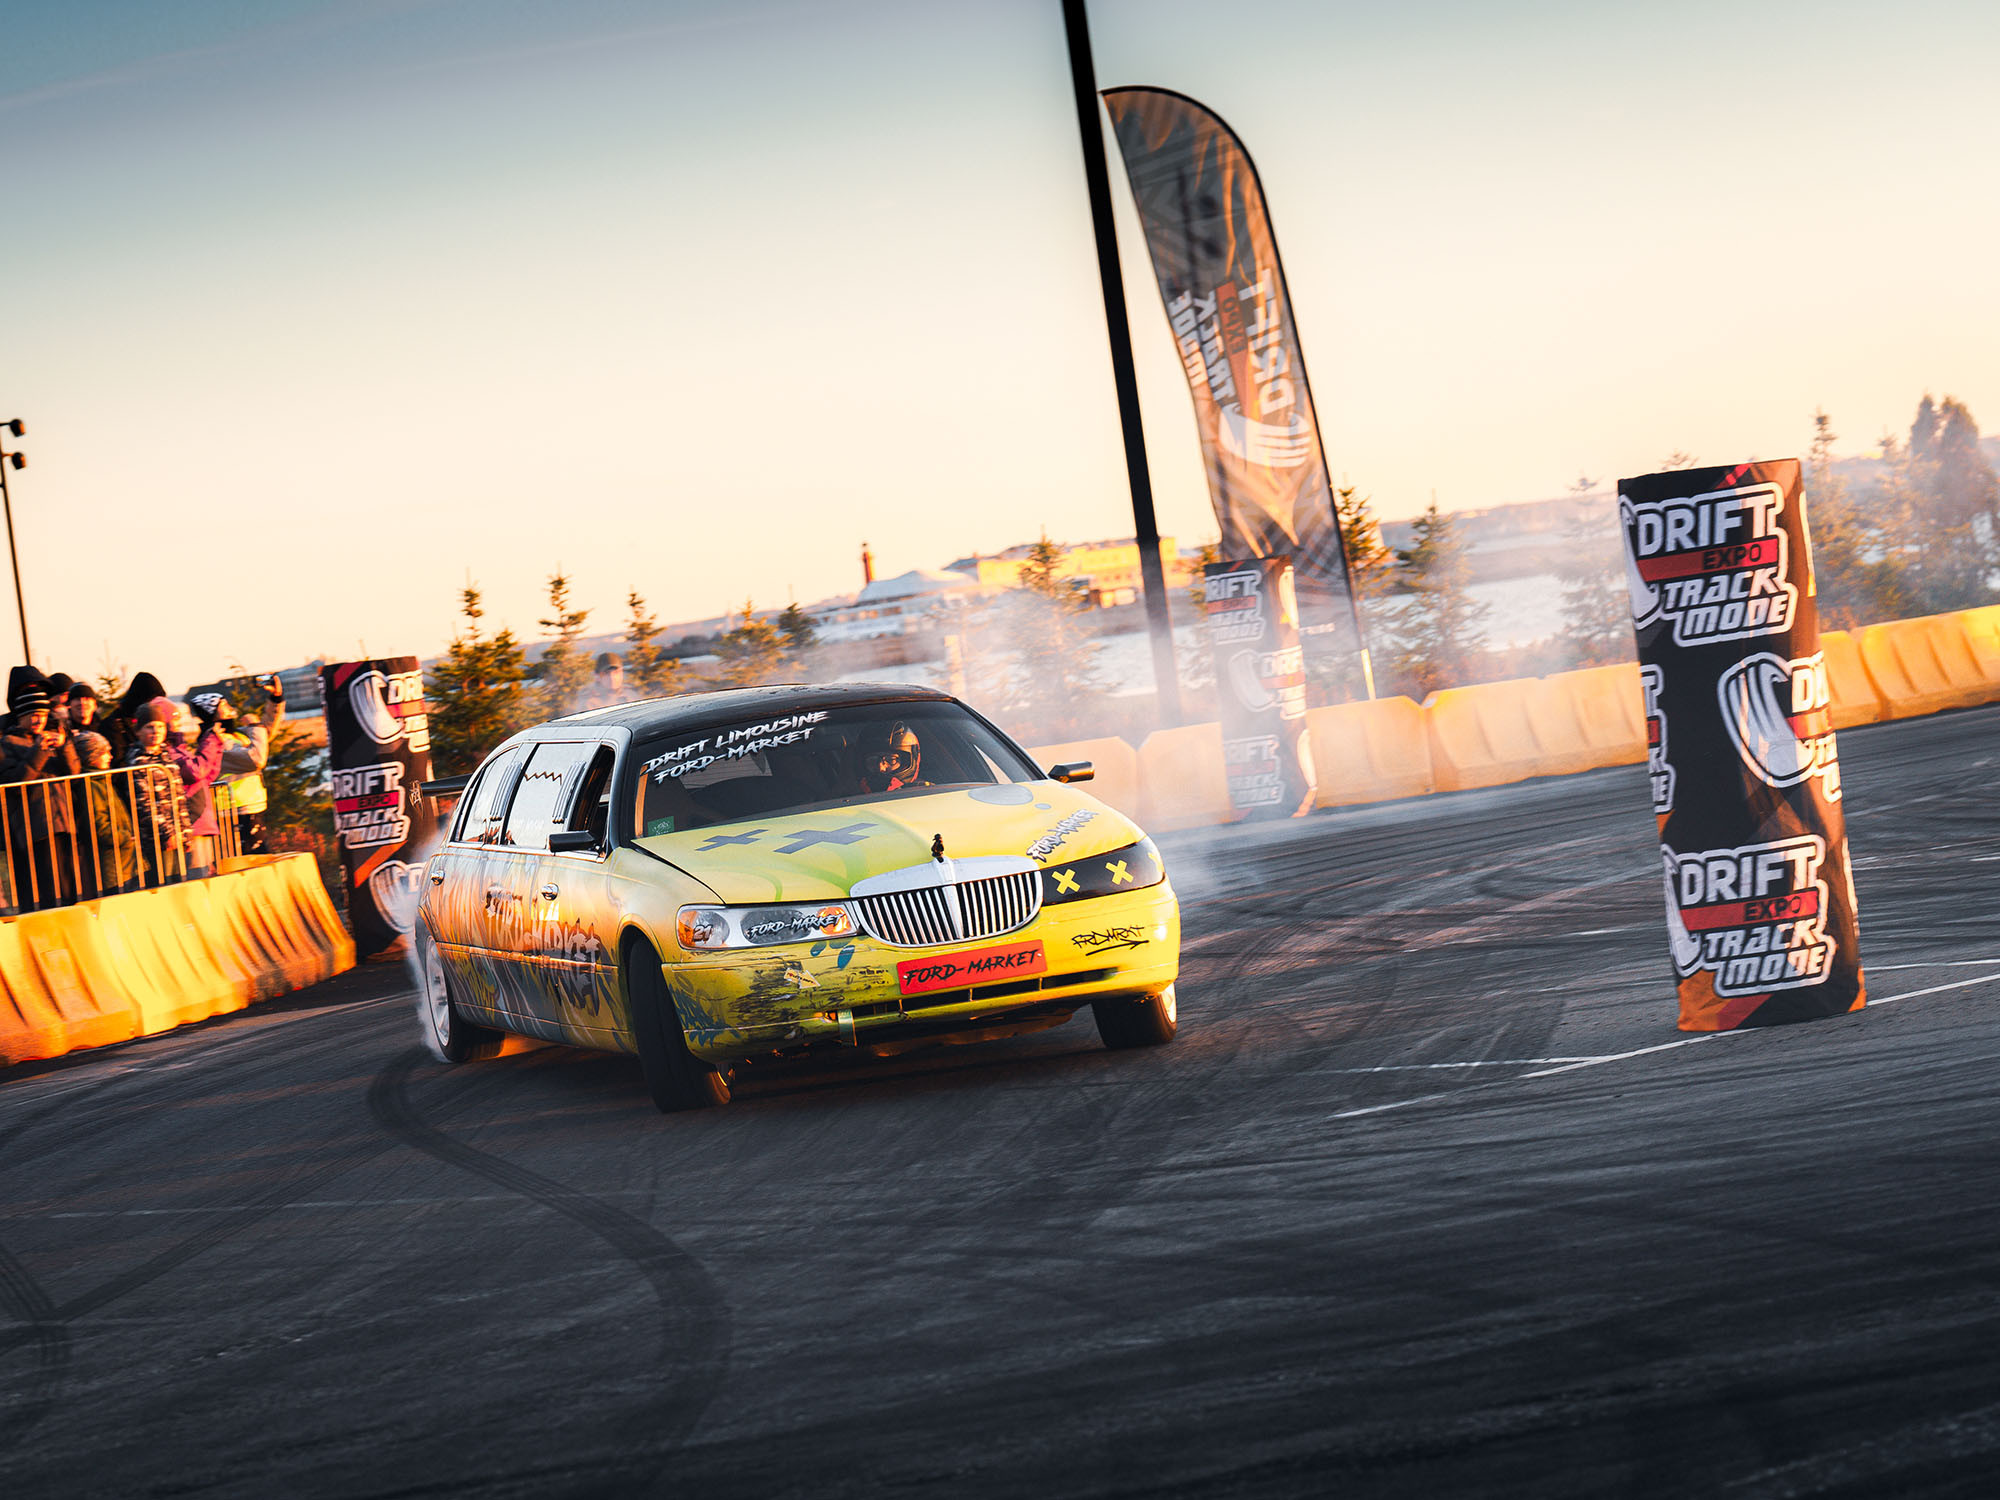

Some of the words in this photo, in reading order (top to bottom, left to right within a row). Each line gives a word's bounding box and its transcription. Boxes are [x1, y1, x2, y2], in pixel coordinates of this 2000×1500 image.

[1638, 493, 1776, 556] DRIFT
[1702, 543, 1762, 570] EXPO
[1664, 566, 1781, 610] TRACK
[1683, 594, 1789, 637] MODE
[643, 737, 711, 775] DRIFT
[715, 711, 830, 750] LIMOUSINE
[653, 727, 815, 784] FORD-MARKET
[1681, 846, 1816, 906] DRIFT
[748, 912, 845, 938] FORD-MARKET
[1744, 895, 1801, 922] EXPO
[1704, 918, 1818, 960] TRACK
[904, 949, 1041, 987] FORD-MARKET
[1724, 945, 1826, 985] MODE
